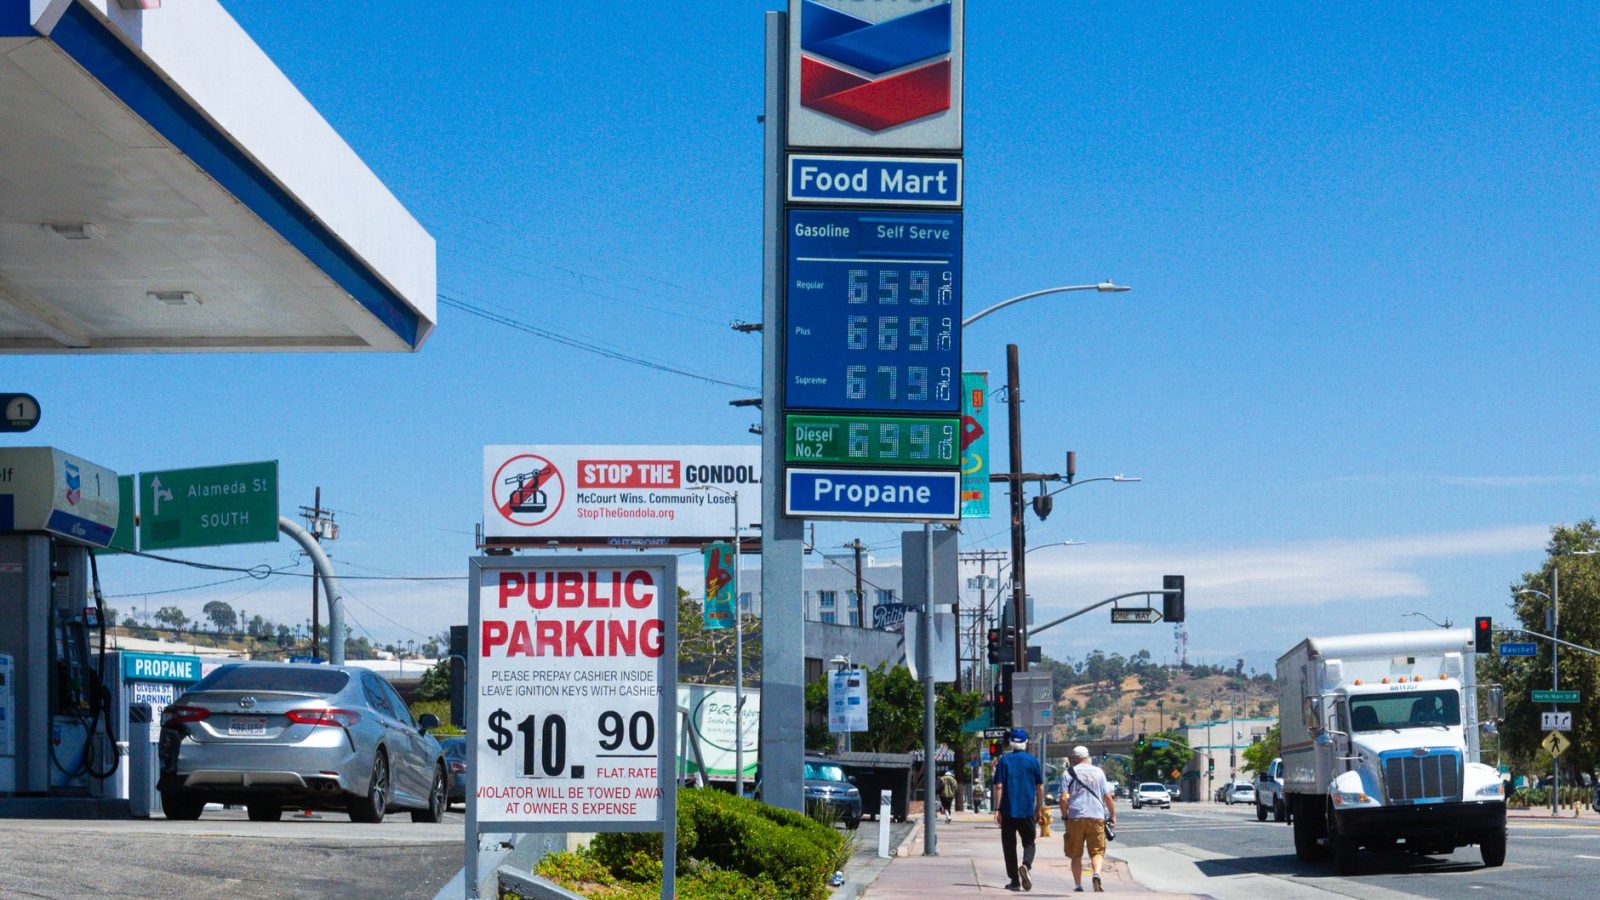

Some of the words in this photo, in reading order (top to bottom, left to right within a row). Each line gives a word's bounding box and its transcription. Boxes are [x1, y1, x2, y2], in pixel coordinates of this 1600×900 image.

[800, 166, 868, 191] Food
[880, 168, 948, 194] Mart
[795, 223, 850, 237] Gasoline
[876, 224, 904, 239] Self
[909, 225, 950, 240] Serve
[796, 280, 825, 290] Regular
[795, 326, 811, 336] Plus
[795, 375, 827, 386] Supreme
[17, 402, 24, 417] 1
[795, 426, 834, 442] Diesel
[795, 444, 824, 458] No.2
[584, 464, 633, 484] STOP
[637, 464, 674, 484] THE
[686, 464, 762, 484] GONDOL
[188, 480, 247, 498] Alameda
[252, 478, 268, 492] St
[814, 478, 931, 507] Propane
[577, 493, 618, 504] McCourt
[619, 493, 647, 504] Wins.
[649, 493, 704, 507] Community
[201, 511, 249, 528] SOUTH
[577, 507, 675, 520] StopTheGondola.org
[499, 570, 654, 610] PUBLIC
[1115, 612, 1128, 620] ONE
[1135, 612, 1150, 620] WAY
[481, 619, 665, 658] PARKING
[135, 659, 192, 678] PROPANE
[491, 670, 530, 682] PLEASE
[532, 670, 571, 682] PREPAY
[573, 670, 618, 682] CASHIER
[620, 670, 653, 682] INSIDE
[136, 685, 160, 693] OLVERA
[481, 685, 513, 697] LEAVE
[515, 685, 559, 697] IGNITION
[561, 685, 589, 697] KEYS
[590, 685, 617, 697] WITH
[619, 685, 663, 697] CASHIER
[136, 694, 172, 705] PARKING
[597, 767, 624, 779] FLAT
[628, 767, 657, 779] RATE
[477, 786, 533, 799] VIOLATOR
[536, 786, 566, 799] WILL
[568, 786, 584, 799] BE
[587, 786, 631, 799] TOWED
[505, 803, 522, 814] AT
[582, 803, 637, 815] EXPENSE
